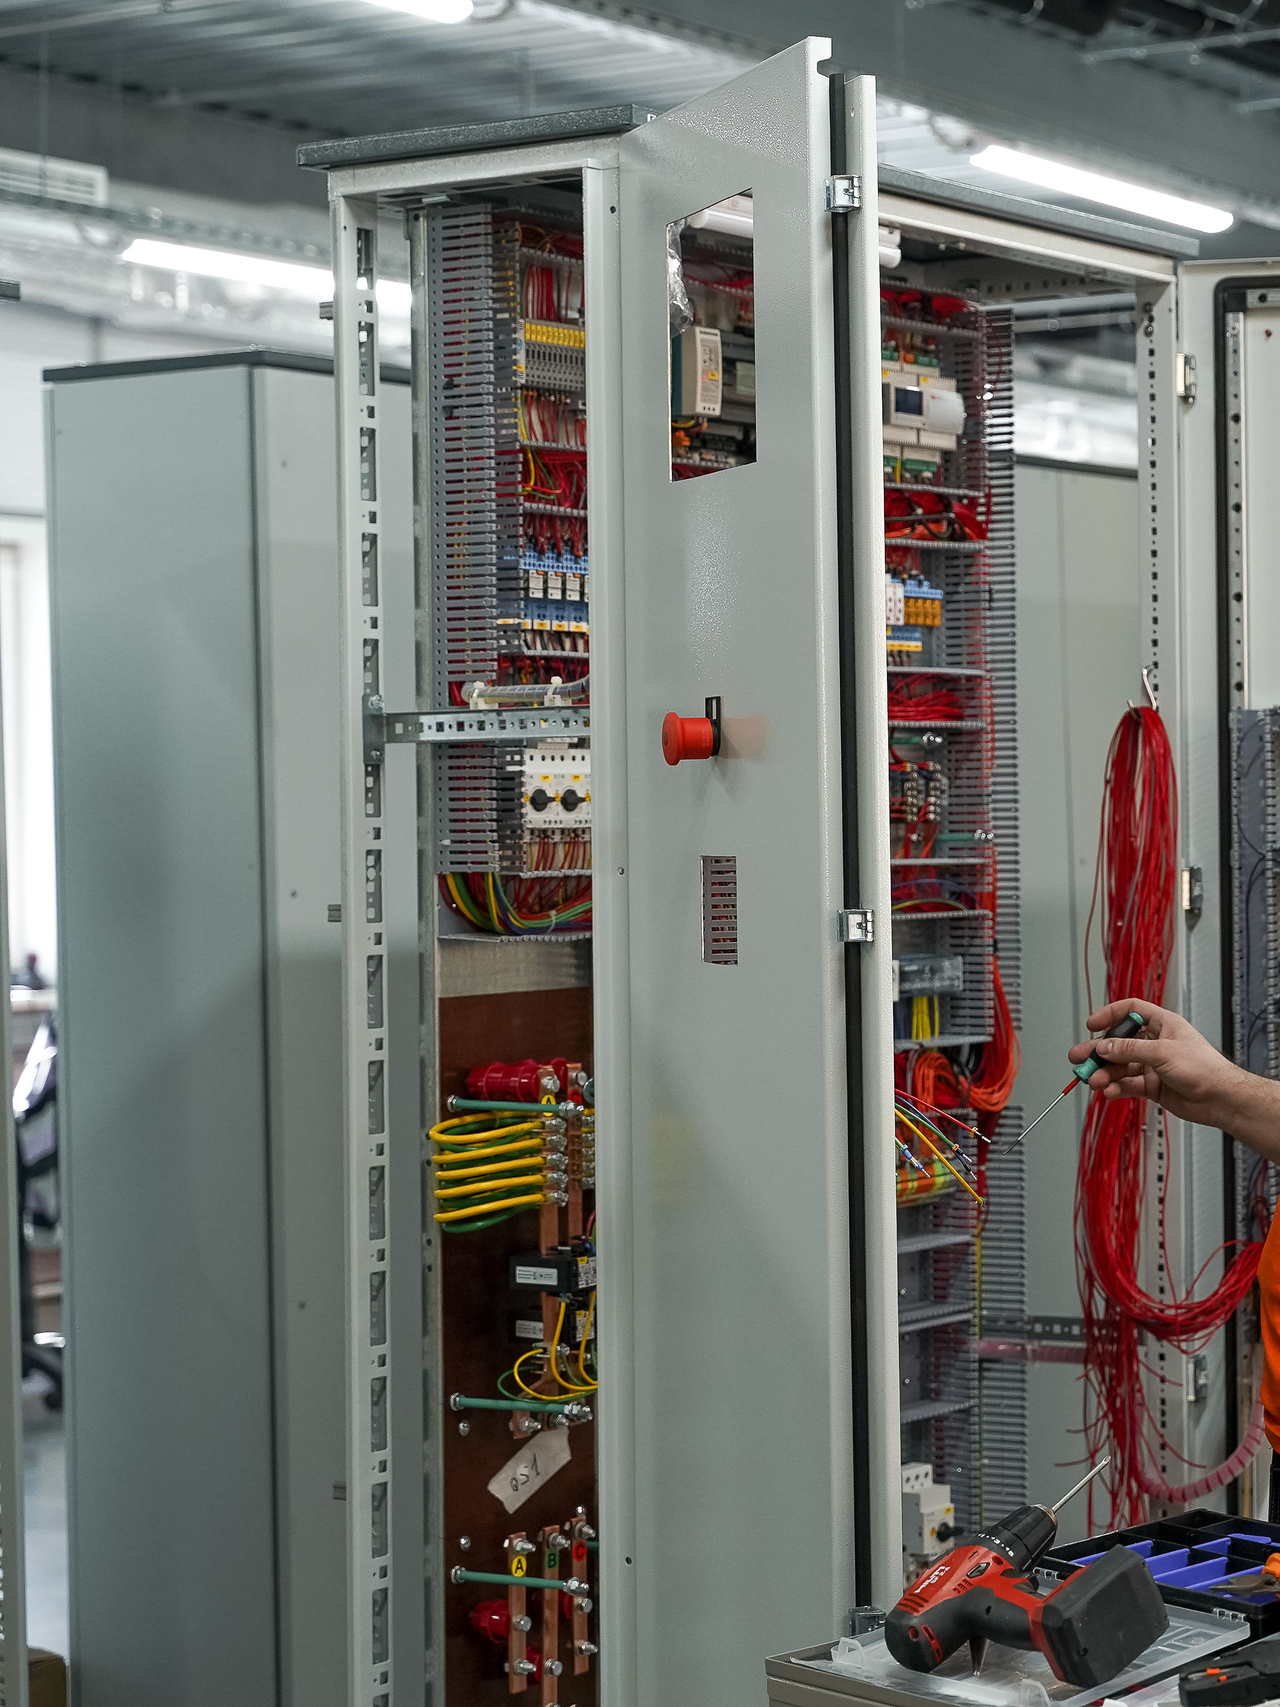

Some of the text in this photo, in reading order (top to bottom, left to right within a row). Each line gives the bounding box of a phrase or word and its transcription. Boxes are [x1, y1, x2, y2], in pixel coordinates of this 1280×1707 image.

[576, 1543, 586, 1559] C
[514, 1557, 525, 1575] A
[547, 1552, 557, 1569] B
